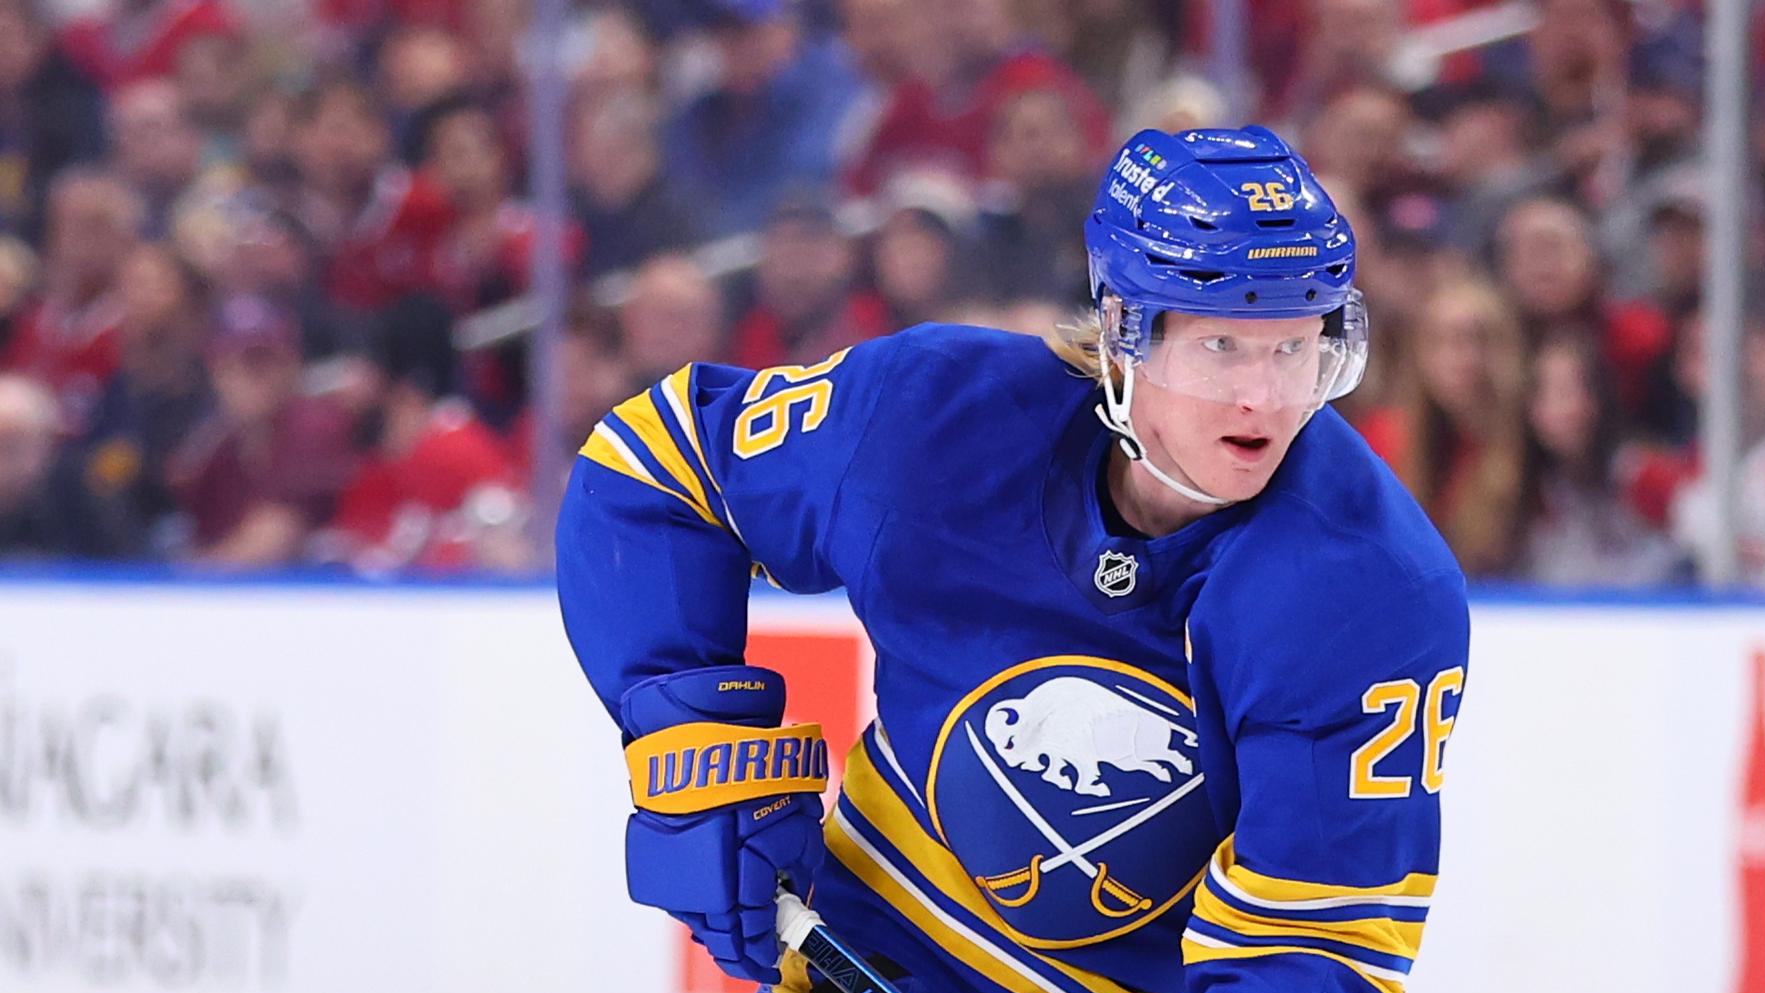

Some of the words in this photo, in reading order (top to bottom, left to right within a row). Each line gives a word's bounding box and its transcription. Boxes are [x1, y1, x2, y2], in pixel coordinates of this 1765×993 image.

[1113, 148, 1175, 203] Trusted
[1241, 183, 1294, 212] 26
[1247, 246, 1318, 260] WARRIOR
[1103, 566, 1129, 585] NHL
[718, 681, 765, 691] DAHLIN
[1349, 665, 1464, 799] 26
[753, 796, 791, 821] COVERT
